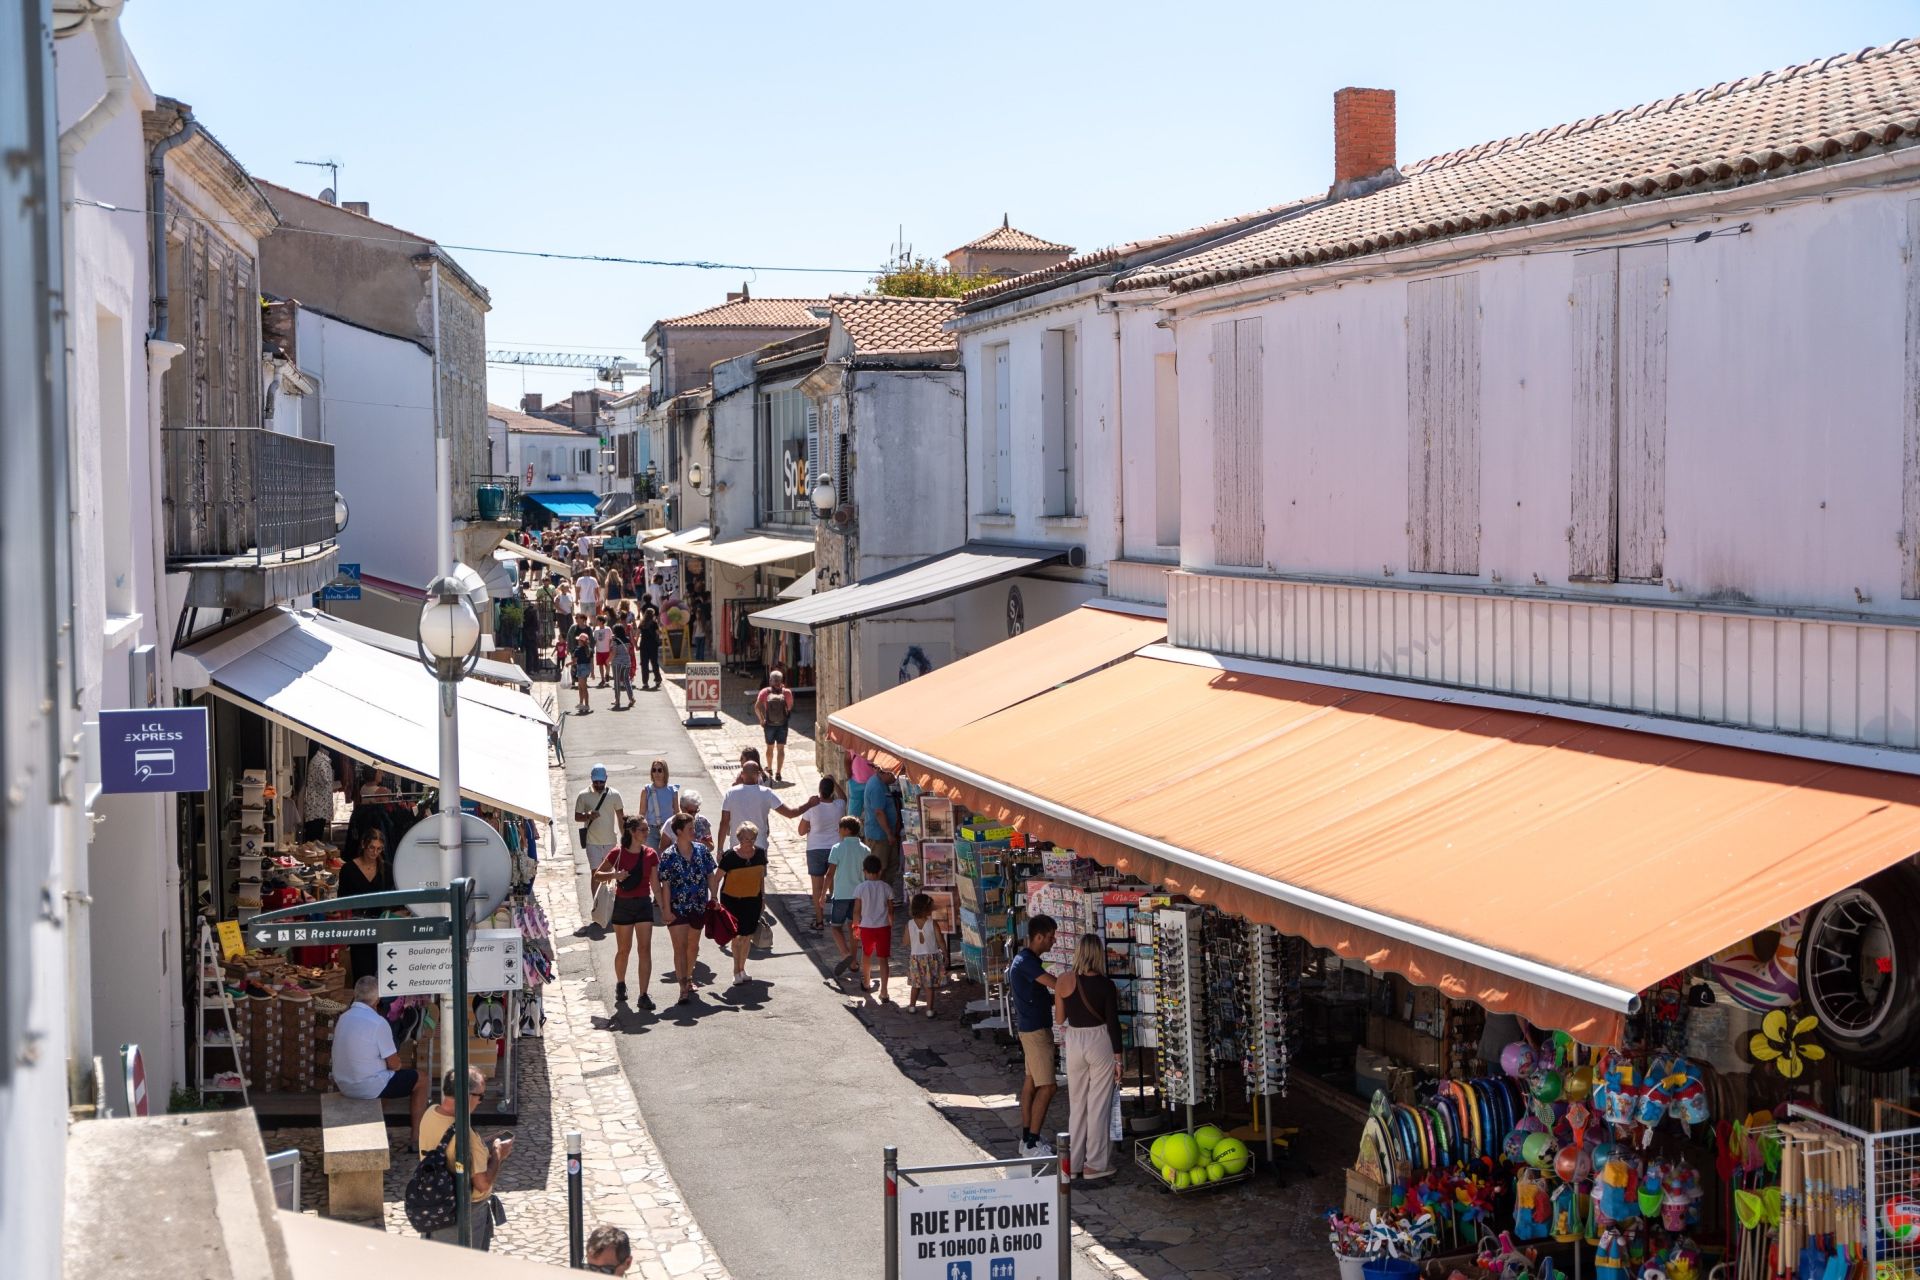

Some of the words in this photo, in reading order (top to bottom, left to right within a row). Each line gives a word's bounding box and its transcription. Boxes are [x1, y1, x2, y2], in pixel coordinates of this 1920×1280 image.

[784, 449, 810, 510] Spea
[687, 666, 719, 676] CHAUSSURES
[688, 680, 719, 700] 10€
[141, 723, 165, 732] LCL
[124, 732, 183, 742] EXPRESS
[310, 928, 377, 939] Restaurants
[412, 925, 416, 933] 1
[418, 925, 434, 933] min
[408, 963, 436, 971] Galerie
[408, 979, 452, 987] Restaurant
[910, 1210, 949, 1236] RUE
[955, 1202, 1050, 1233] PIÉTONNE
[918, 1241, 936, 1259] DE
[939, 1237, 987, 1258] 10H00
[989, 1233, 1000, 1254] À
[1003, 1233, 1043, 1252] 6H00
